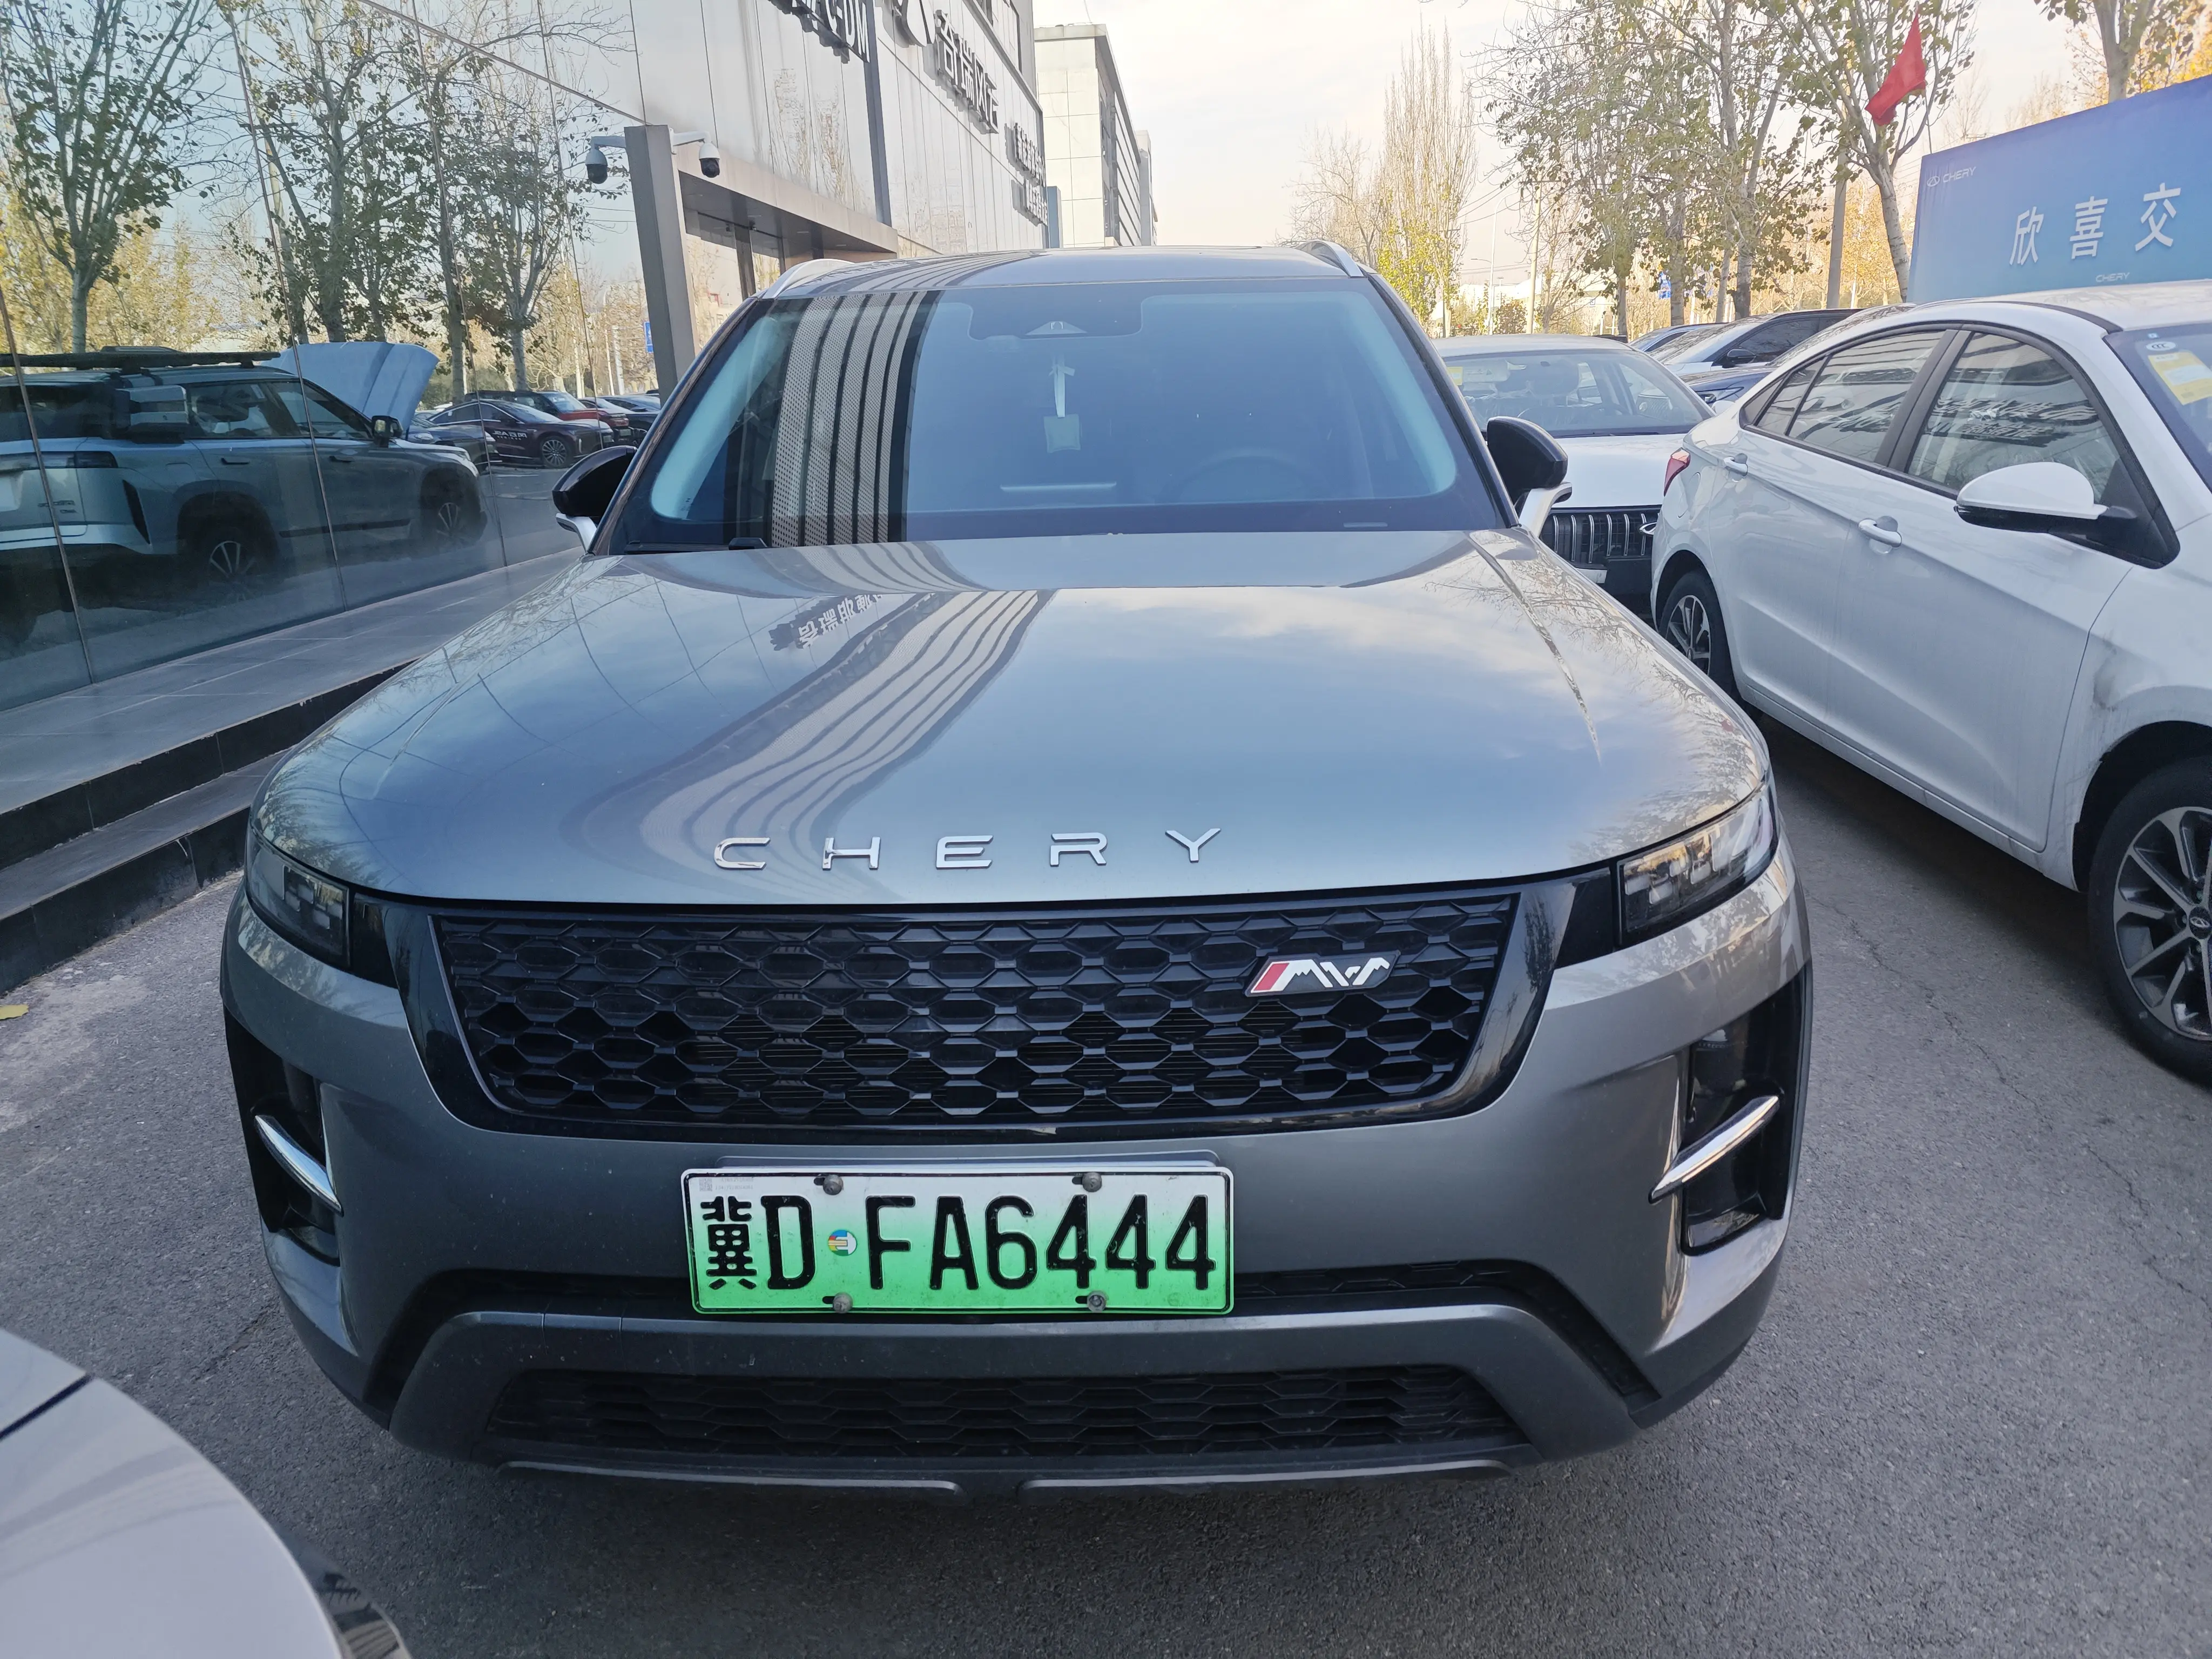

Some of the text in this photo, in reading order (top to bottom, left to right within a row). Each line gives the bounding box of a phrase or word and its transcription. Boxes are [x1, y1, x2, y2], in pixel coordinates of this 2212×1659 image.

[936, 10, 999, 133] 奇瑞风云
[1943, 166, 1977, 183] CHERY
[2009, 183, 2181, 265] 欣喜交
[2096, 272, 2130, 282] CHERY
[713, 827, 1221, 870] CHERY
